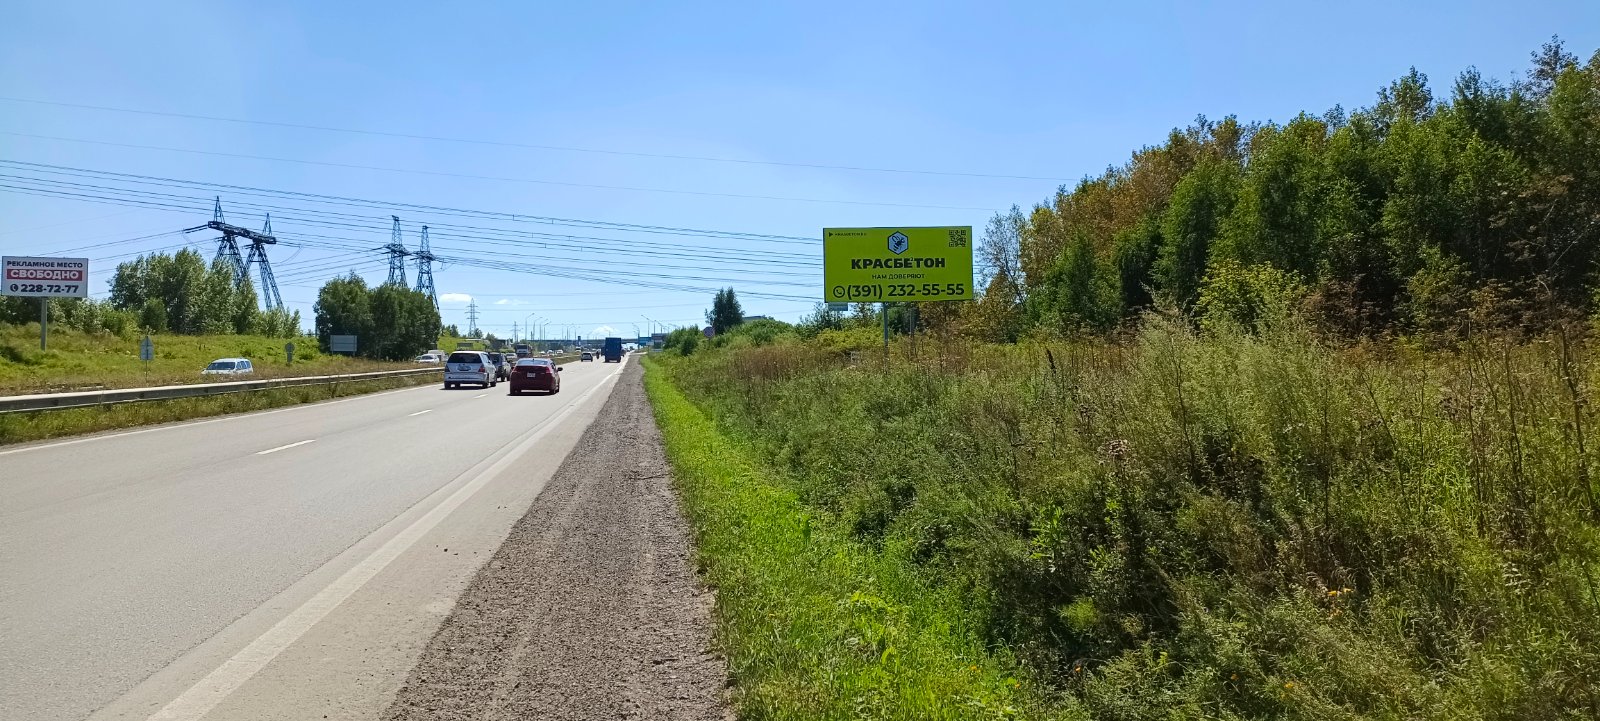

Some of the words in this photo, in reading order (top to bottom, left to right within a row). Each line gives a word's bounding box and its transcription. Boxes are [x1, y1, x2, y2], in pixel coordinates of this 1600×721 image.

[852, 258, 945, 269] КРАСБЕТОН
[11, 270, 79, 279] СВОБОДНО
[21, 284, 79, 293] 228-72-77
[847, 284, 882, 300] (391)
[888, 284, 964, 296] 232-55-55
